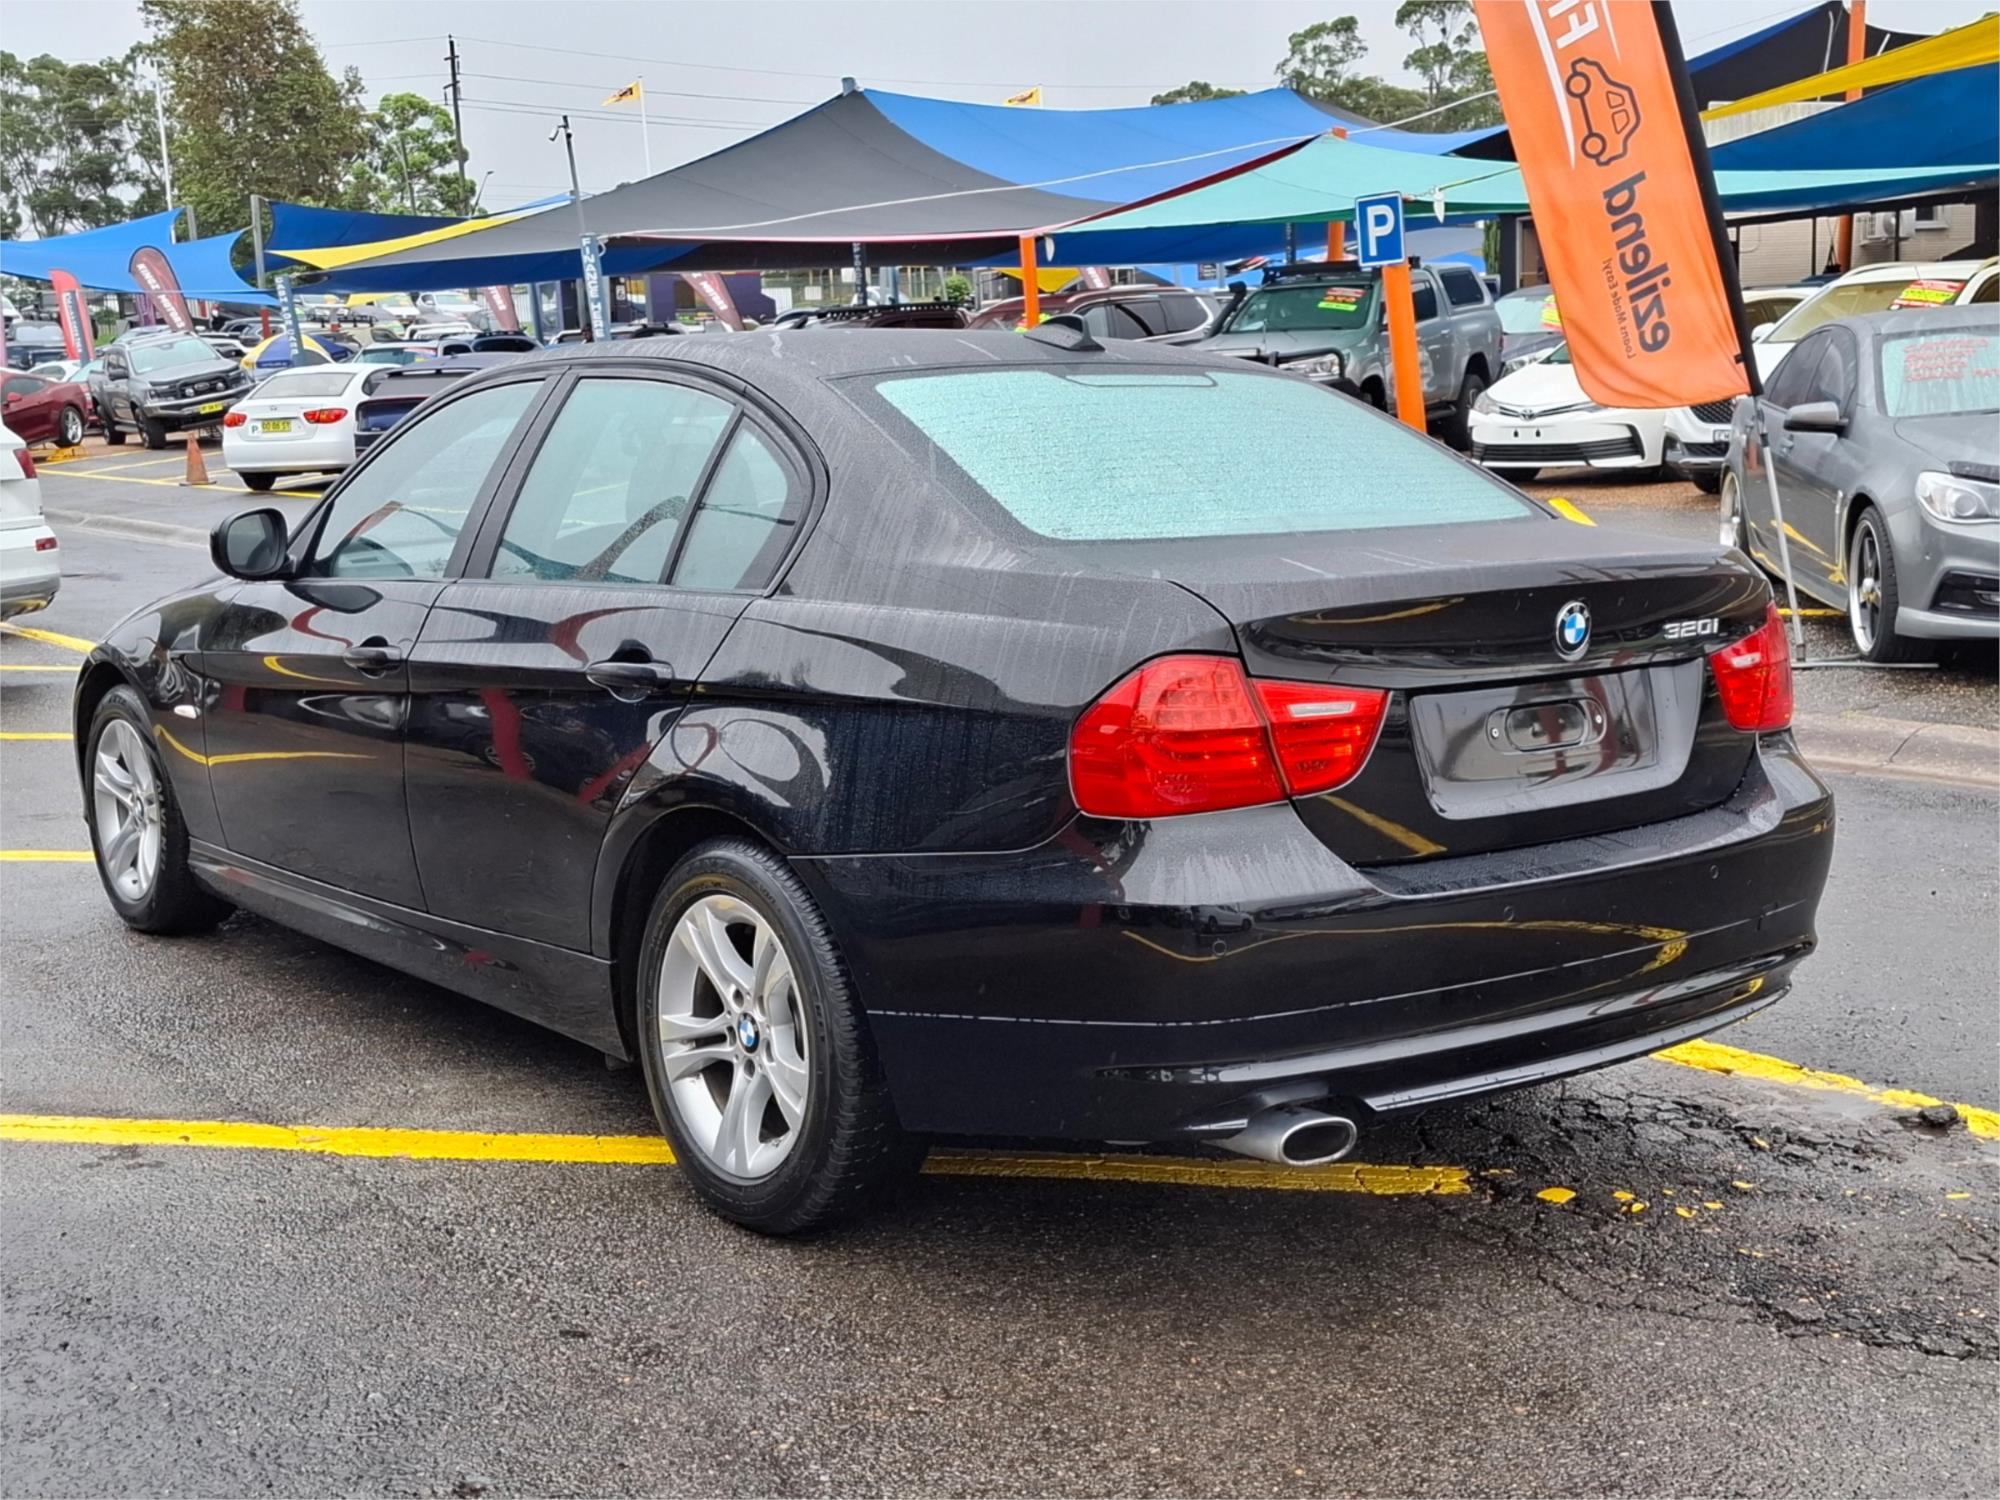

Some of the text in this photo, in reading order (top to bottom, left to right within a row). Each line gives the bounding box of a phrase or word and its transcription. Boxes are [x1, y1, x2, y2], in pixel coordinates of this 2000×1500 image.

[1366, 204, 1395, 257] P
[581, 237, 605, 337] FINANCE HERE
